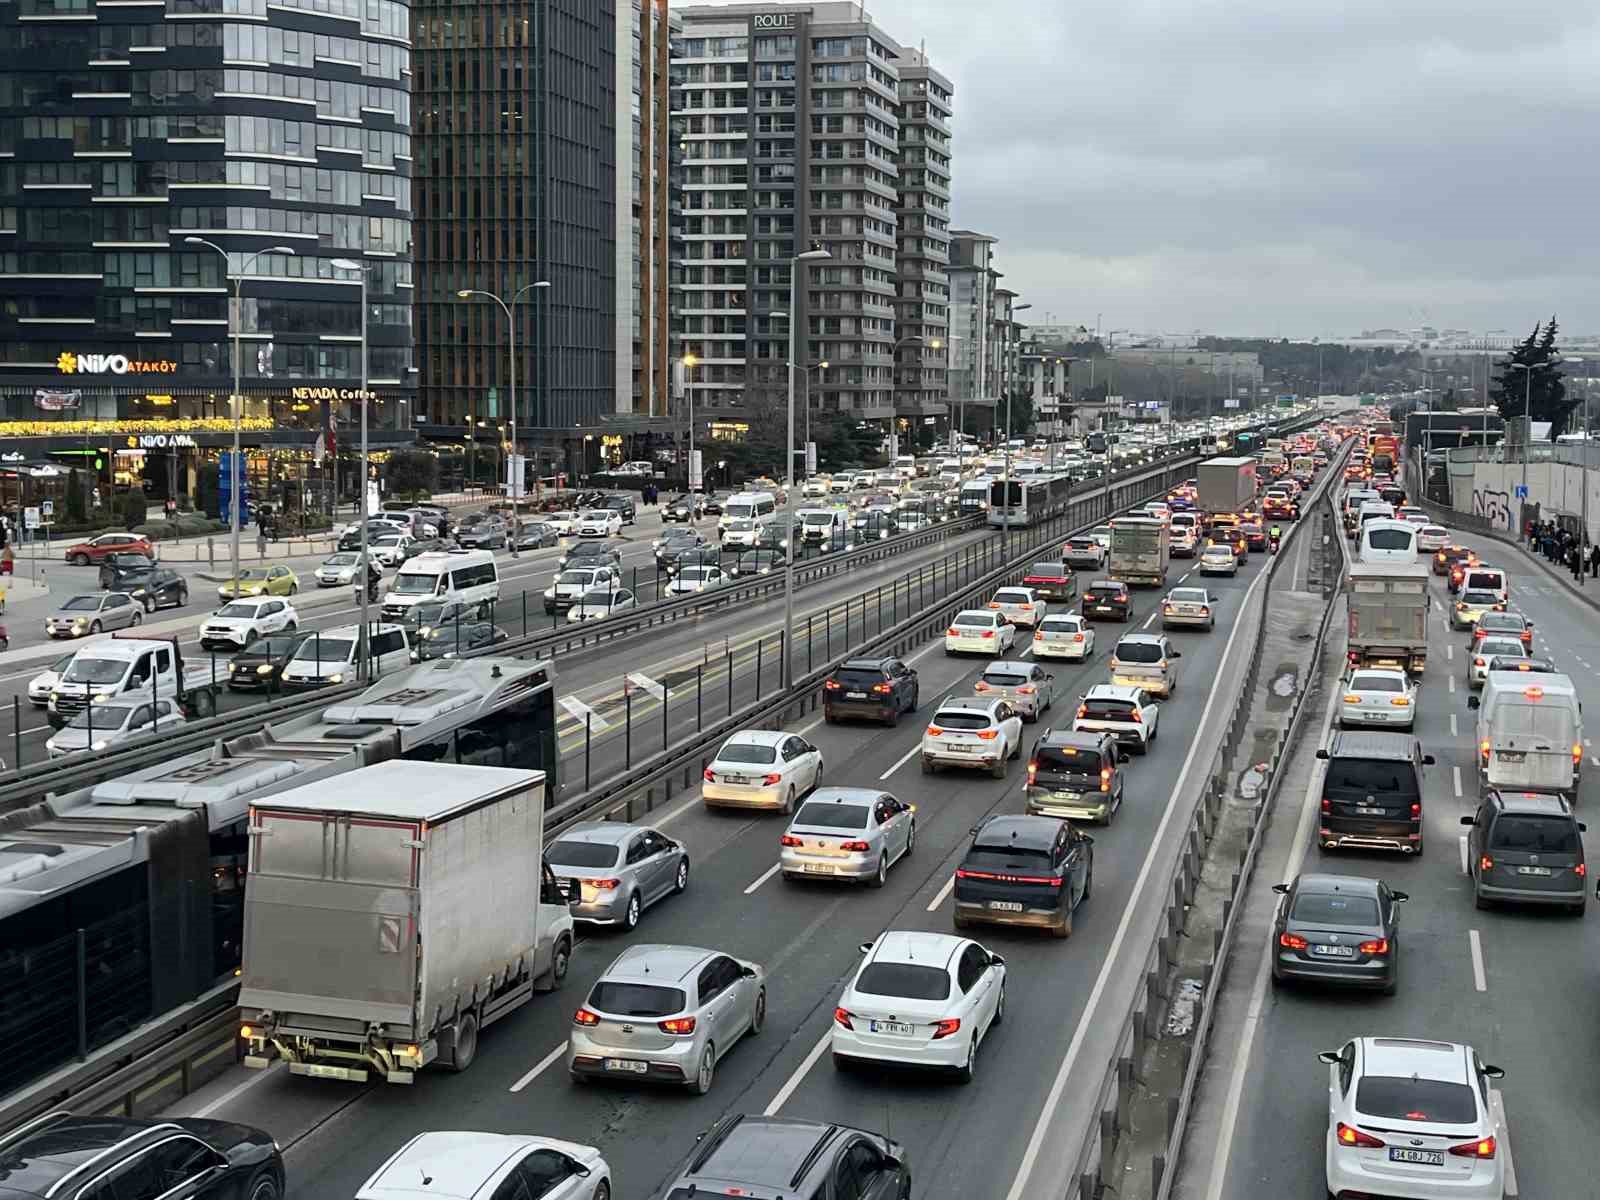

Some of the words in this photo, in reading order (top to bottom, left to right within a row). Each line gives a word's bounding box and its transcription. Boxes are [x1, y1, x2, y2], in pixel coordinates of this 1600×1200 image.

[754, 14, 796, 27] ROUTE
[127, 361, 177, 372] ATAKÖY
[292, 387, 338, 399] NEVADA
